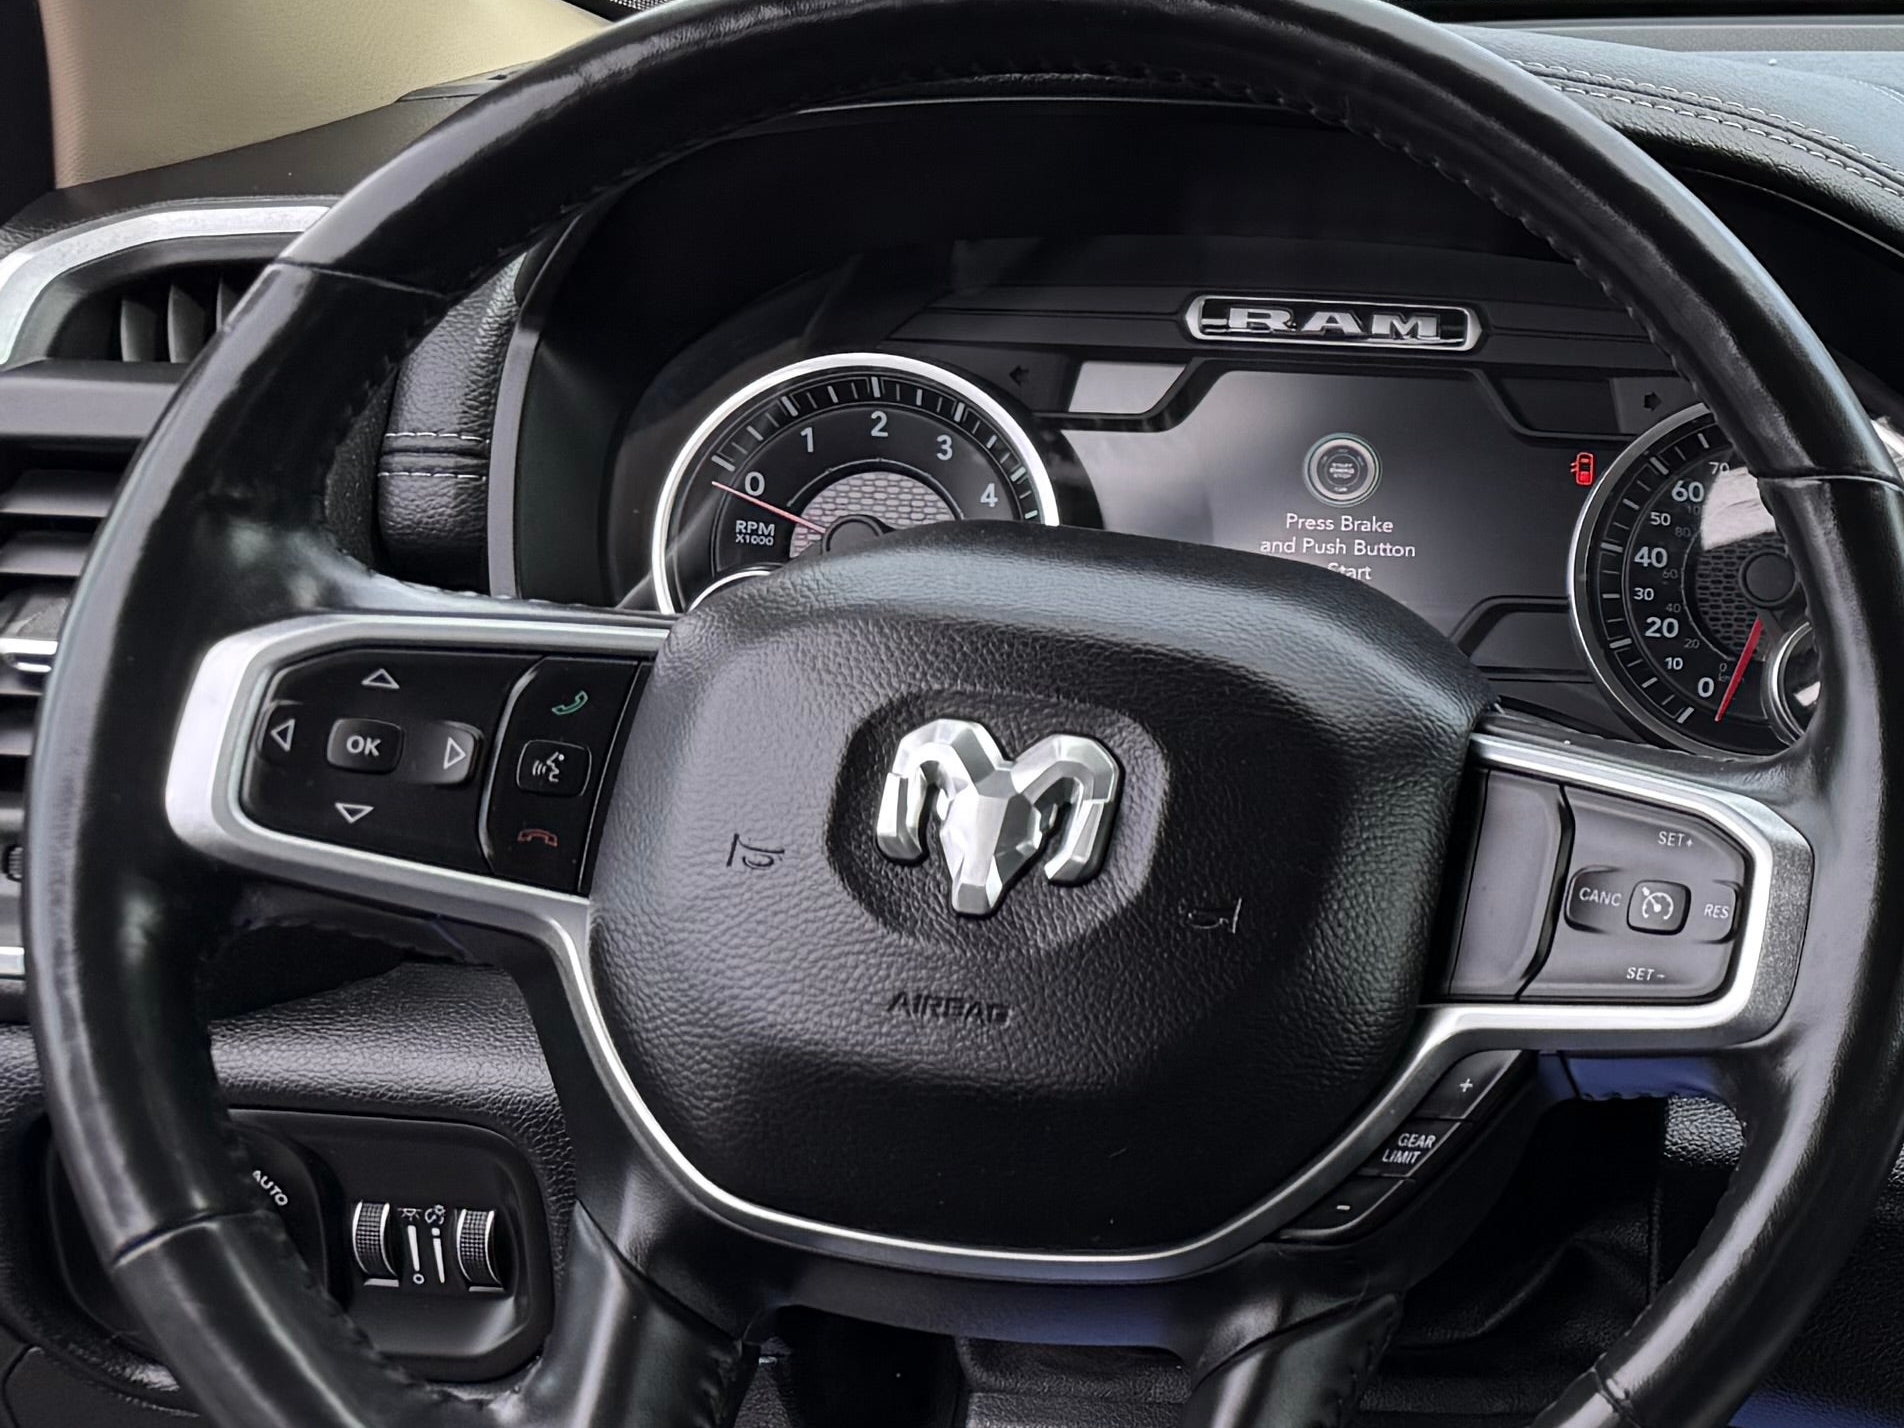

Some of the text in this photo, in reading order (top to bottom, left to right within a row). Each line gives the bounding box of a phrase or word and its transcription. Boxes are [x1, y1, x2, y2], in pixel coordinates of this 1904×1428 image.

[1228, 307, 1442, 339] RAM
[870, 410, 889, 438] 2
[800, 426, 815, 453] 1
[936, 433, 953, 461] 3
[744, 471, 766, 496] 0
[1671, 481, 1705, 503] 60
[980, 482, 998, 508] 4
[735, 519, 775, 537] RPM
[1285, 513, 1394, 533] Press Brake
[1649, 511, 1671, 526] 50
[735, 532, 775, 547] X1000
[1260, 536, 1417, 558] and Push Button
[1633, 546, 1668, 568] 40
[1633, 587, 1655, 602] 30
[1644, 616, 1679, 638] 20
[1664, 656, 1684, 671] 10
[1697, 676, 1715, 698] 0
[346, 734, 382, 757] OK
[1579, 886, 1623, 907] CANC
[1703, 903, 1730, 919] RES
[1397, 1132, 1437, 1149] GEAR
[1381, 1148, 1421, 1164] LIMIT
[251, 1169, 290, 1208] AUTO
